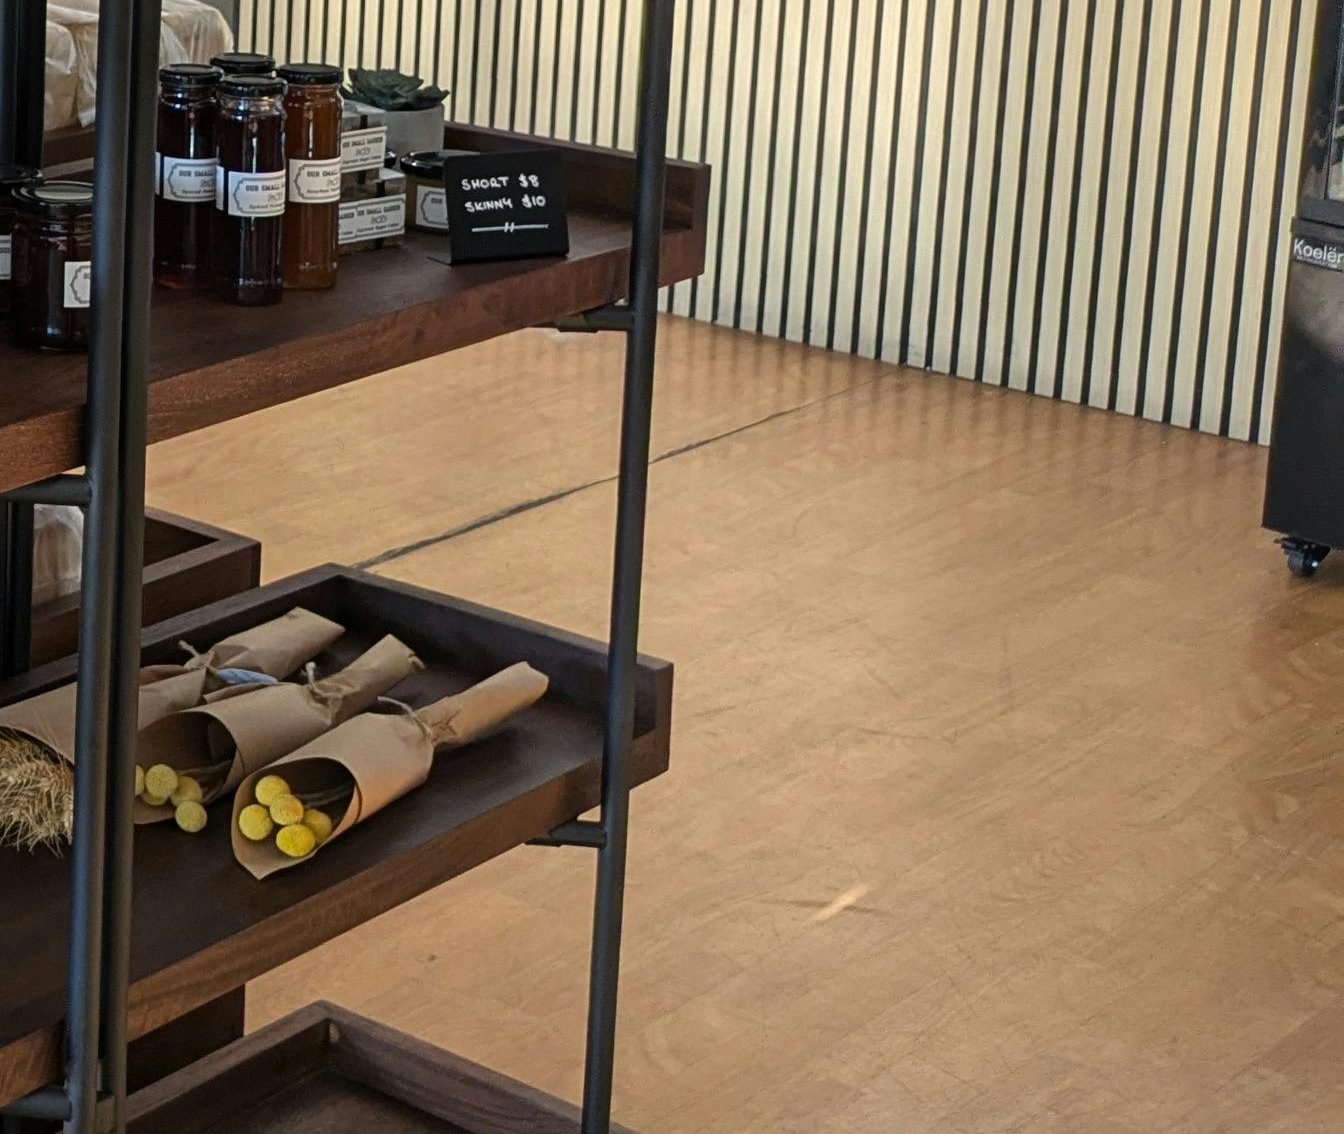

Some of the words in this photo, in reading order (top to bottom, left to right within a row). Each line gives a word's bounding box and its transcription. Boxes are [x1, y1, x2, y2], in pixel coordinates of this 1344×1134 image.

[462, 177, 509, 190] SHORT
[518, 173, 540, 188] $8
[464, 198, 513, 213] SKINNY
[521, 195, 546, 210] $10
